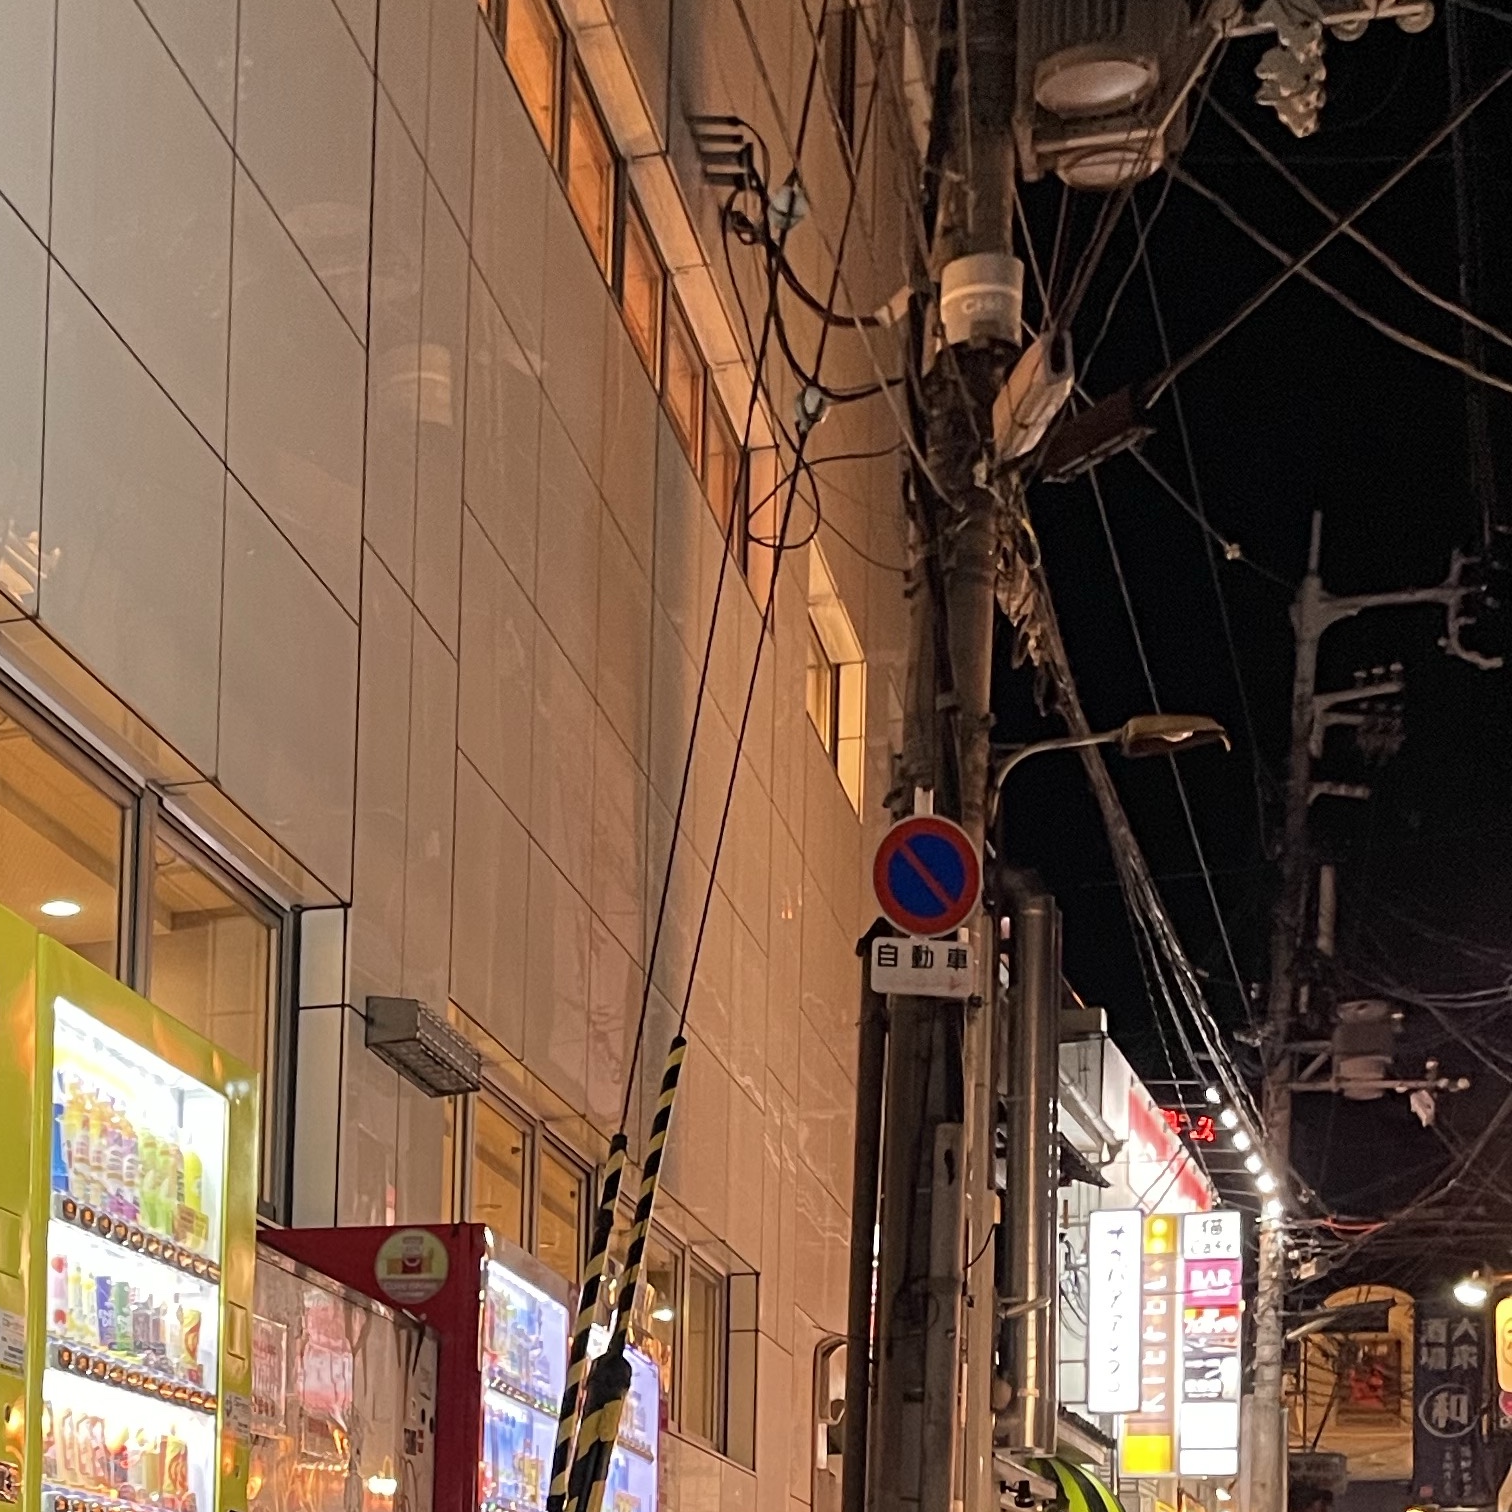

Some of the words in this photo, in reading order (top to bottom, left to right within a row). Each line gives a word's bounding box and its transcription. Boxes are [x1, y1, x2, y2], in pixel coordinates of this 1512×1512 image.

[878, 943, 968, 971] 自動車
[1190, 1269, 1232, 1289] BAR
